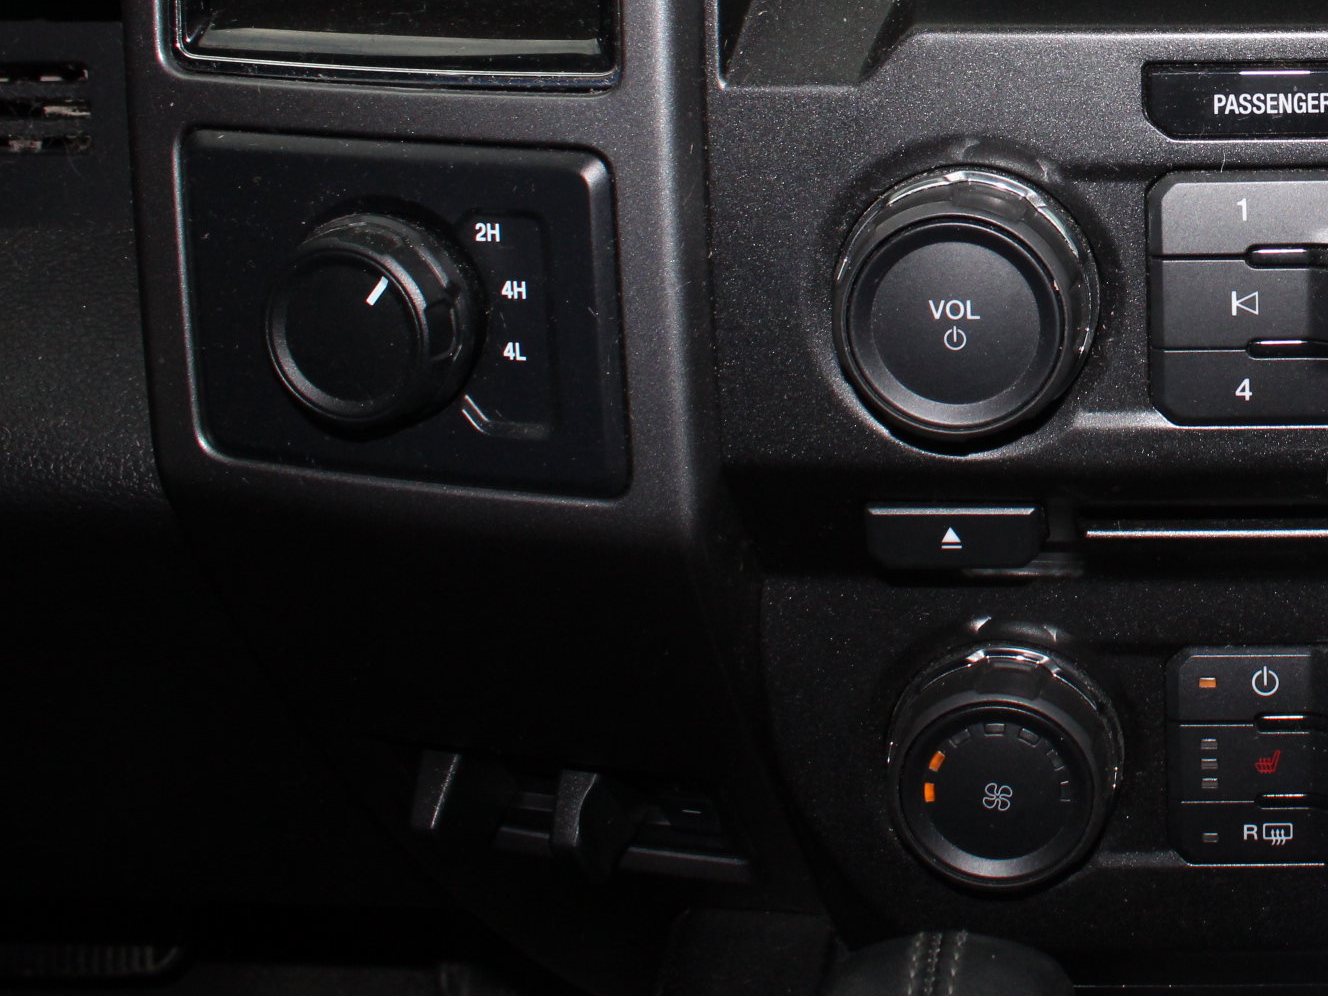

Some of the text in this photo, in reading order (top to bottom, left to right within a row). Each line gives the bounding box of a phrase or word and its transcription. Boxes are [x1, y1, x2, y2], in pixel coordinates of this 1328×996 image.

[1236, 198, 1248, 221] 1
[475, 222, 501, 242] 2H
[501, 280, 526, 300] 4H
[928, 299, 981, 320] VOL
[503, 342, 526, 361] 4L
[1235, 378, 1253, 400] 4
[1243, 824, 1258, 840] R
